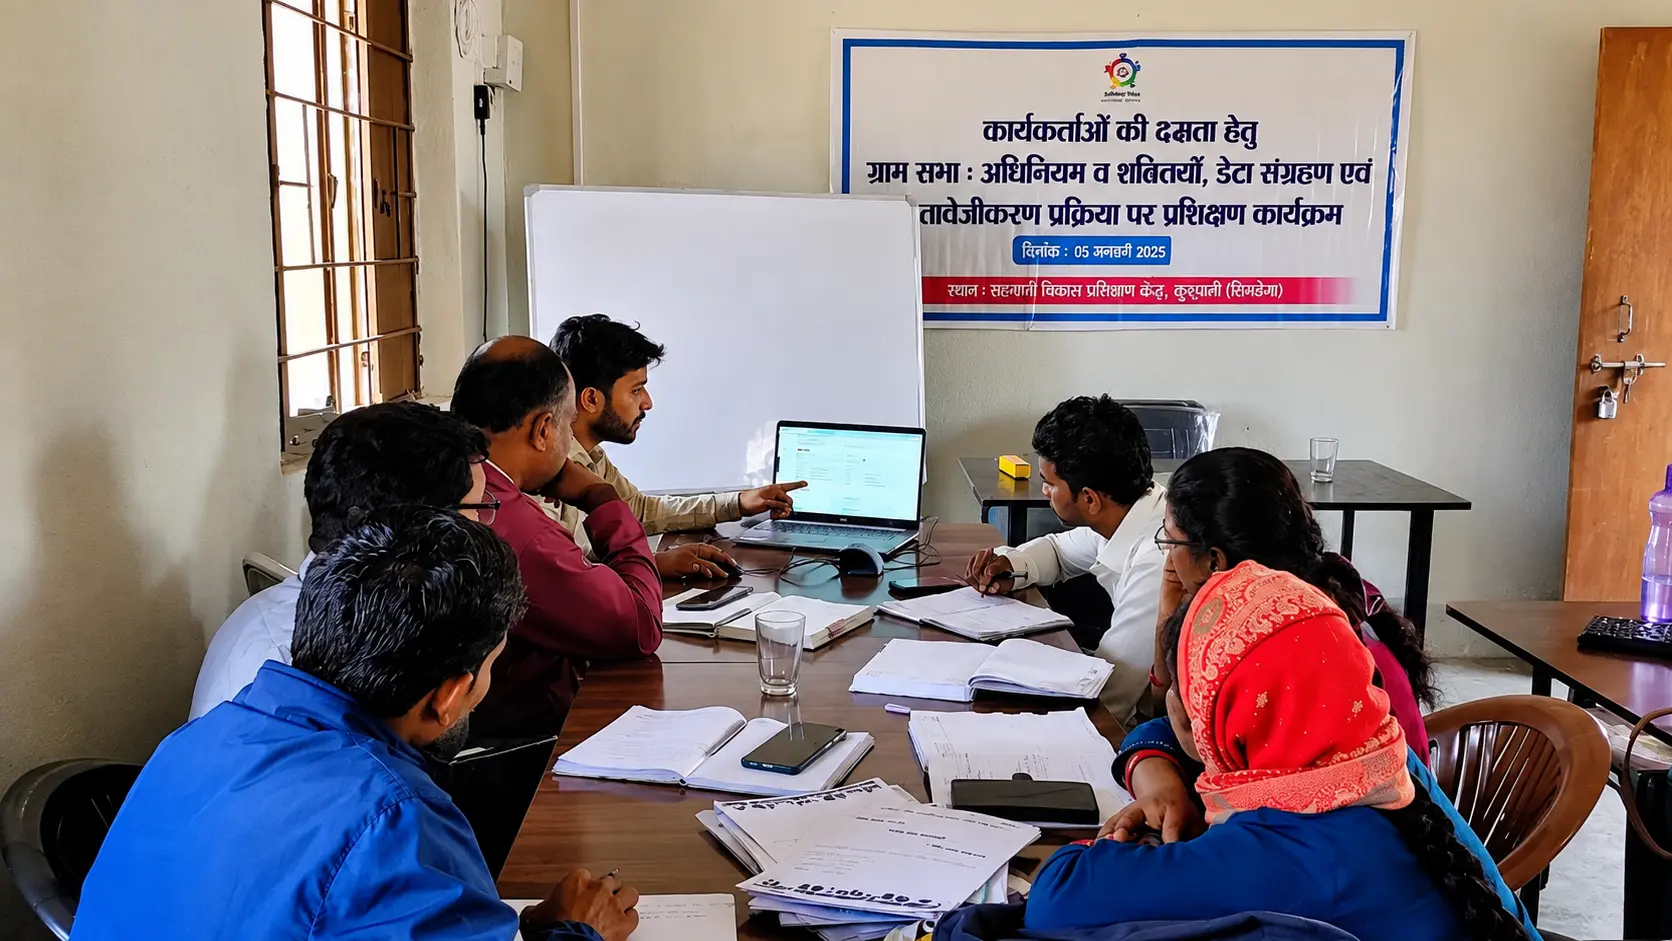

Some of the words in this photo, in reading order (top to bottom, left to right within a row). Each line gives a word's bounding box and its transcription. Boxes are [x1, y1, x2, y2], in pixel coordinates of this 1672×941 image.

[983, 113, 1110, 142] कार्यकर्ताओं
[1116, 113, 1149, 142] की
[1224, 115, 1258, 150] हेतु
[866, 162, 909, 184] ग्राम
[915, 162, 961, 184] सभा
[981, 154, 1087, 184] अधिनियम
[1093, 162, 1110, 184] व
[1216, 156, 1254, 184] डेटा
[1260, 157, 1334, 185] संग्रहण
[1340, 157, 1373, 185] एवं
[919, 196, 1042, 226] तावेजीकरण
[1048, 196, 1121, 227] प्रक्रिया
[1126, 204, 1157, 226] पर
[1163, 196, 1247, 227] प्रशिक्षण
[1253, 196, 1345, 227] कार्यक्रम
[1074, 245, 1089, 258] 05
[1136, 245, 1166, 258] 2025
[1041, 280, 1082, 297] विकास
